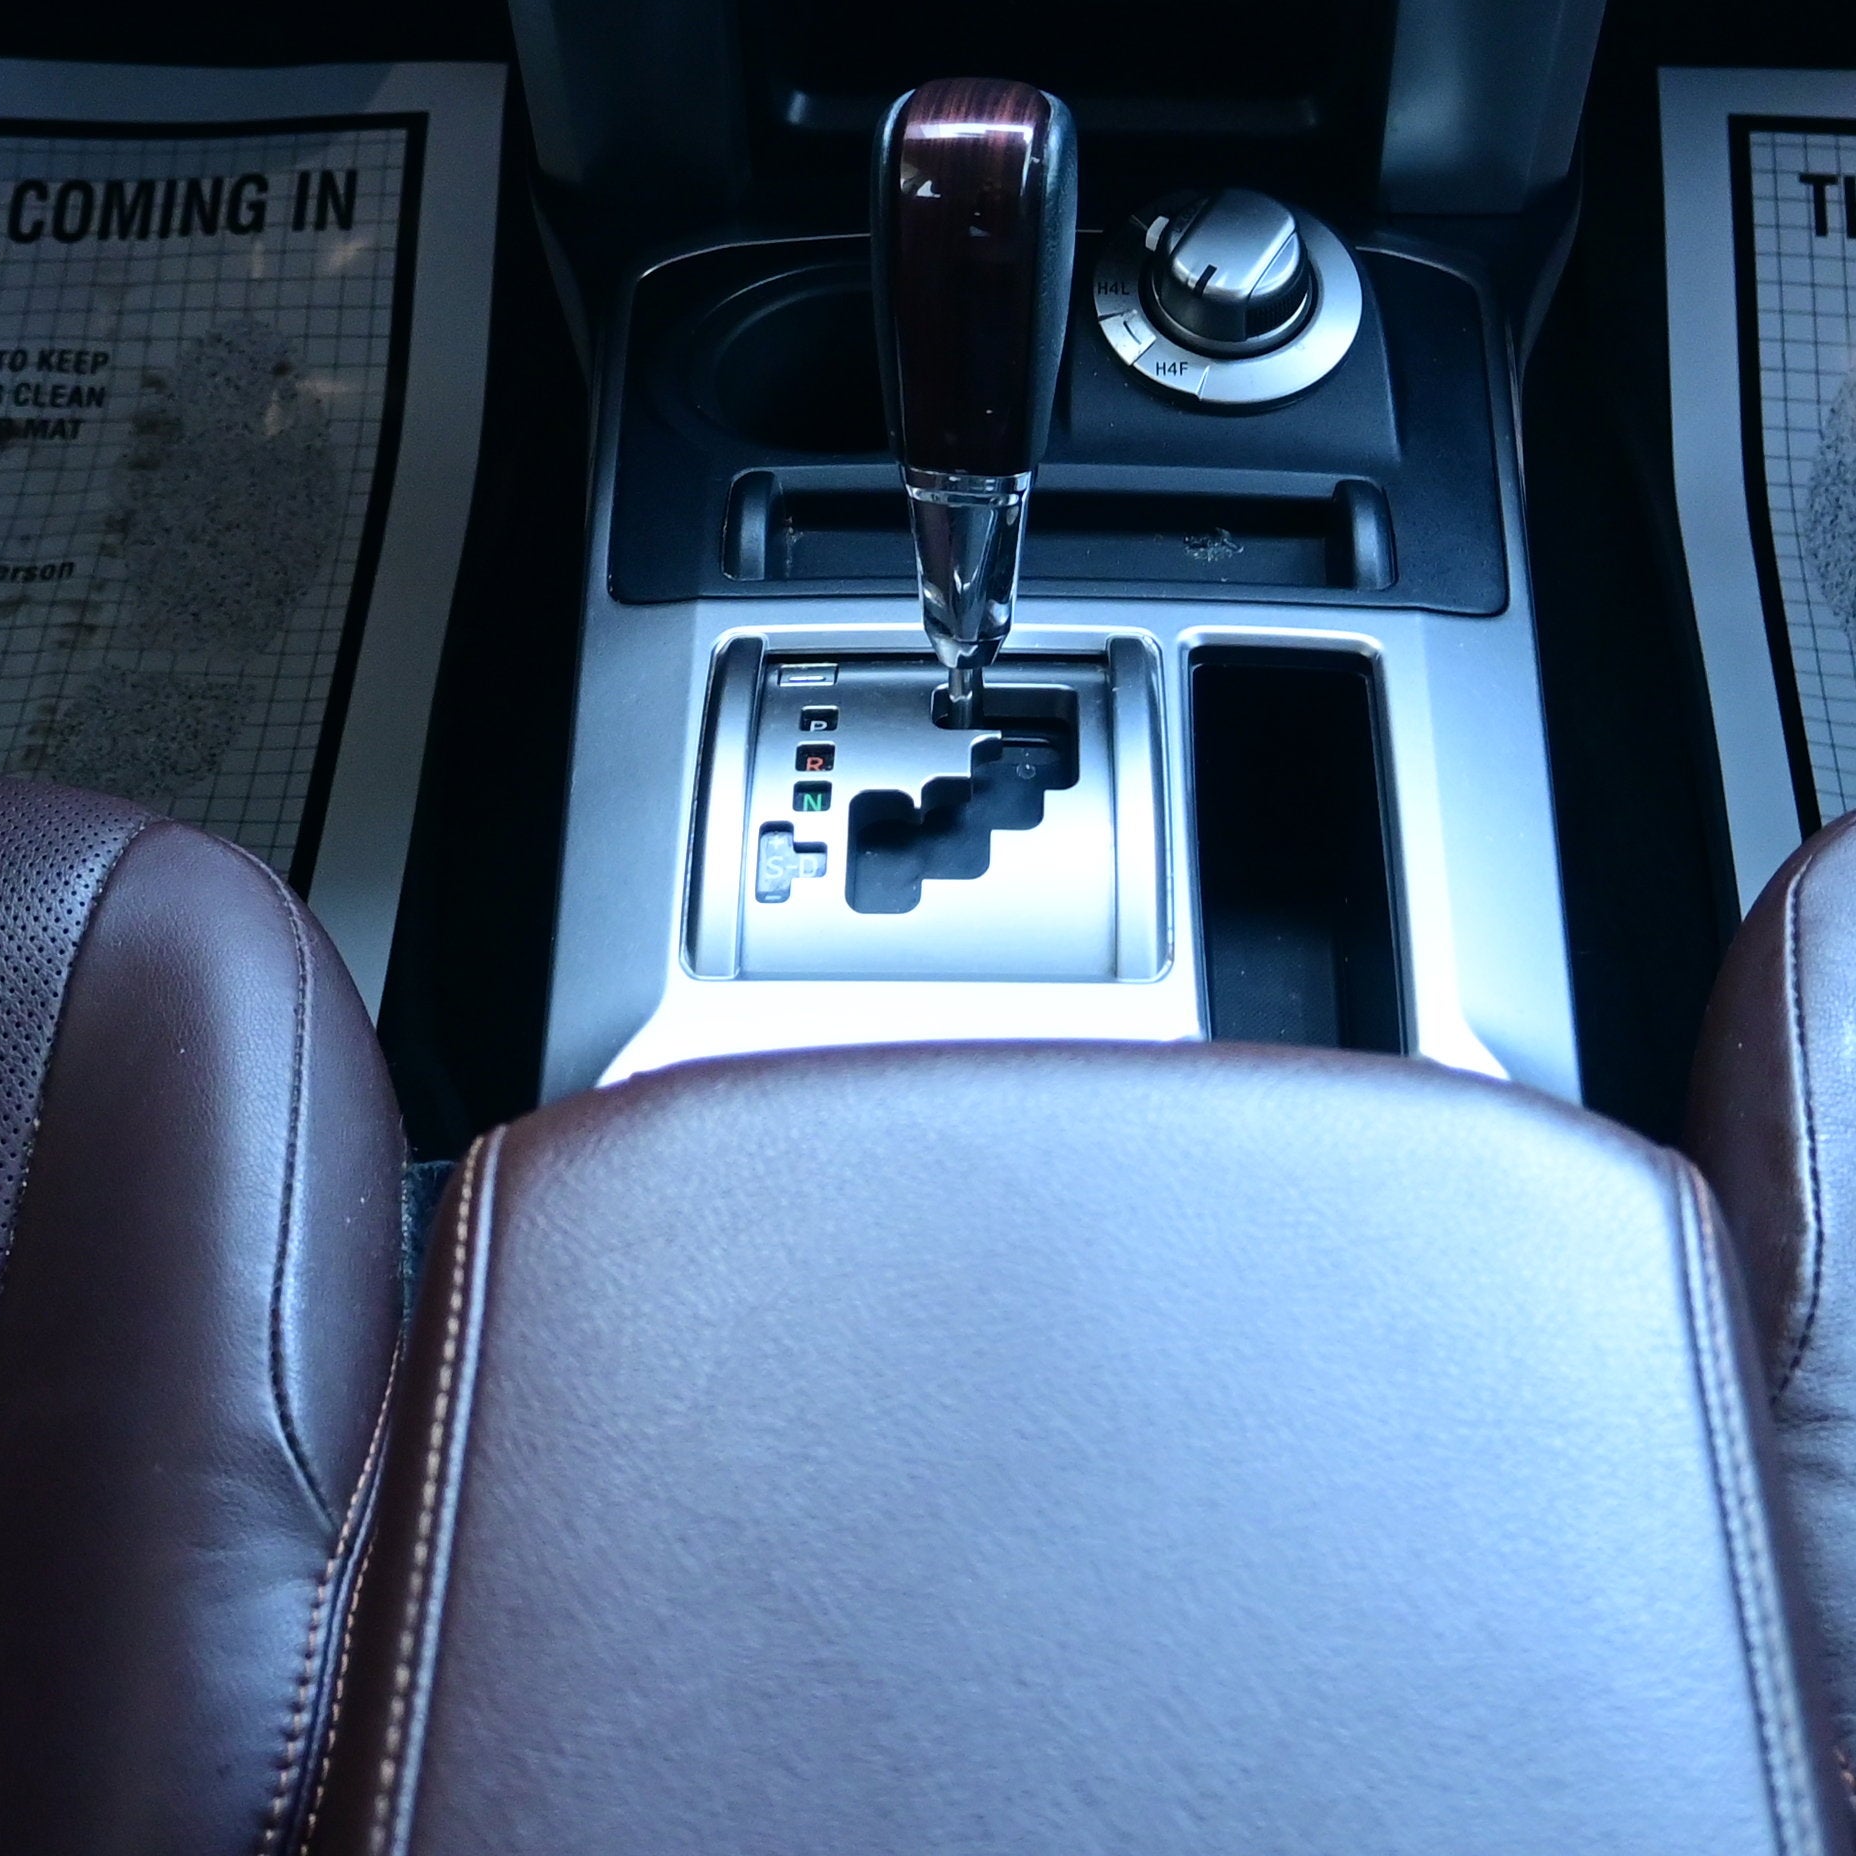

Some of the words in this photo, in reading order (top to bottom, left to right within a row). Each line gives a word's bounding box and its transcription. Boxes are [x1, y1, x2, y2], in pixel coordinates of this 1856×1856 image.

[6, 170, 270, 245] COMING
[290, 168, 359, 234] IN
[1097, 281, 1130, 295] H4L
[35, 348, 110, 376] KEEP
[1155, 361, 1189, 377] H4F
[12, 382, 106, 408] CLEAN
[22, 417, 86, 441] MAT
[810, 719, 828, 732] P
[806, 756, 825, 772] R
[802, 793, 823, 812] N
